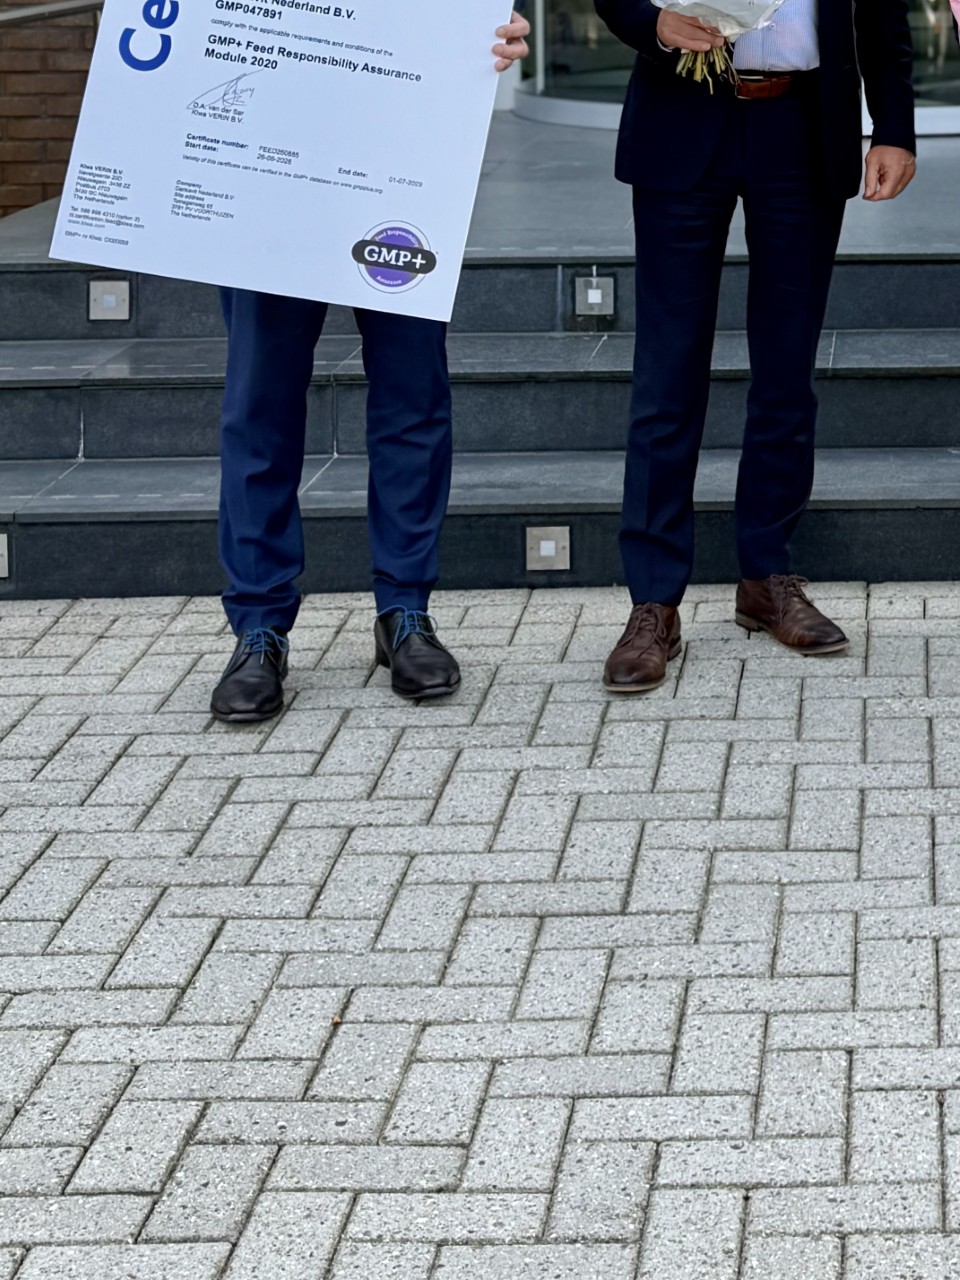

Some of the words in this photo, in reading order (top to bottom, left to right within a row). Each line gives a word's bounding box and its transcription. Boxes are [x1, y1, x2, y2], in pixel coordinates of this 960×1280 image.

[215, 0, 282, 19] GMP047891
[333, 7, 355, 20] B.V.
[204, 47, 246, 64] Module
[251, 56, 277, 69] 2020
[207, 34, 242, 47] GMP+
[245, 40, 274, 54] Feed
[277, 46, 358, 72] Responsibility
[361, 62, 421, 81] Assurance
[184, 140, 201, 149] Start
[186, 133, 220, 144] Certificate
[337, 167, 351, 175] End
[364, 245, 425, 268] GMP+
